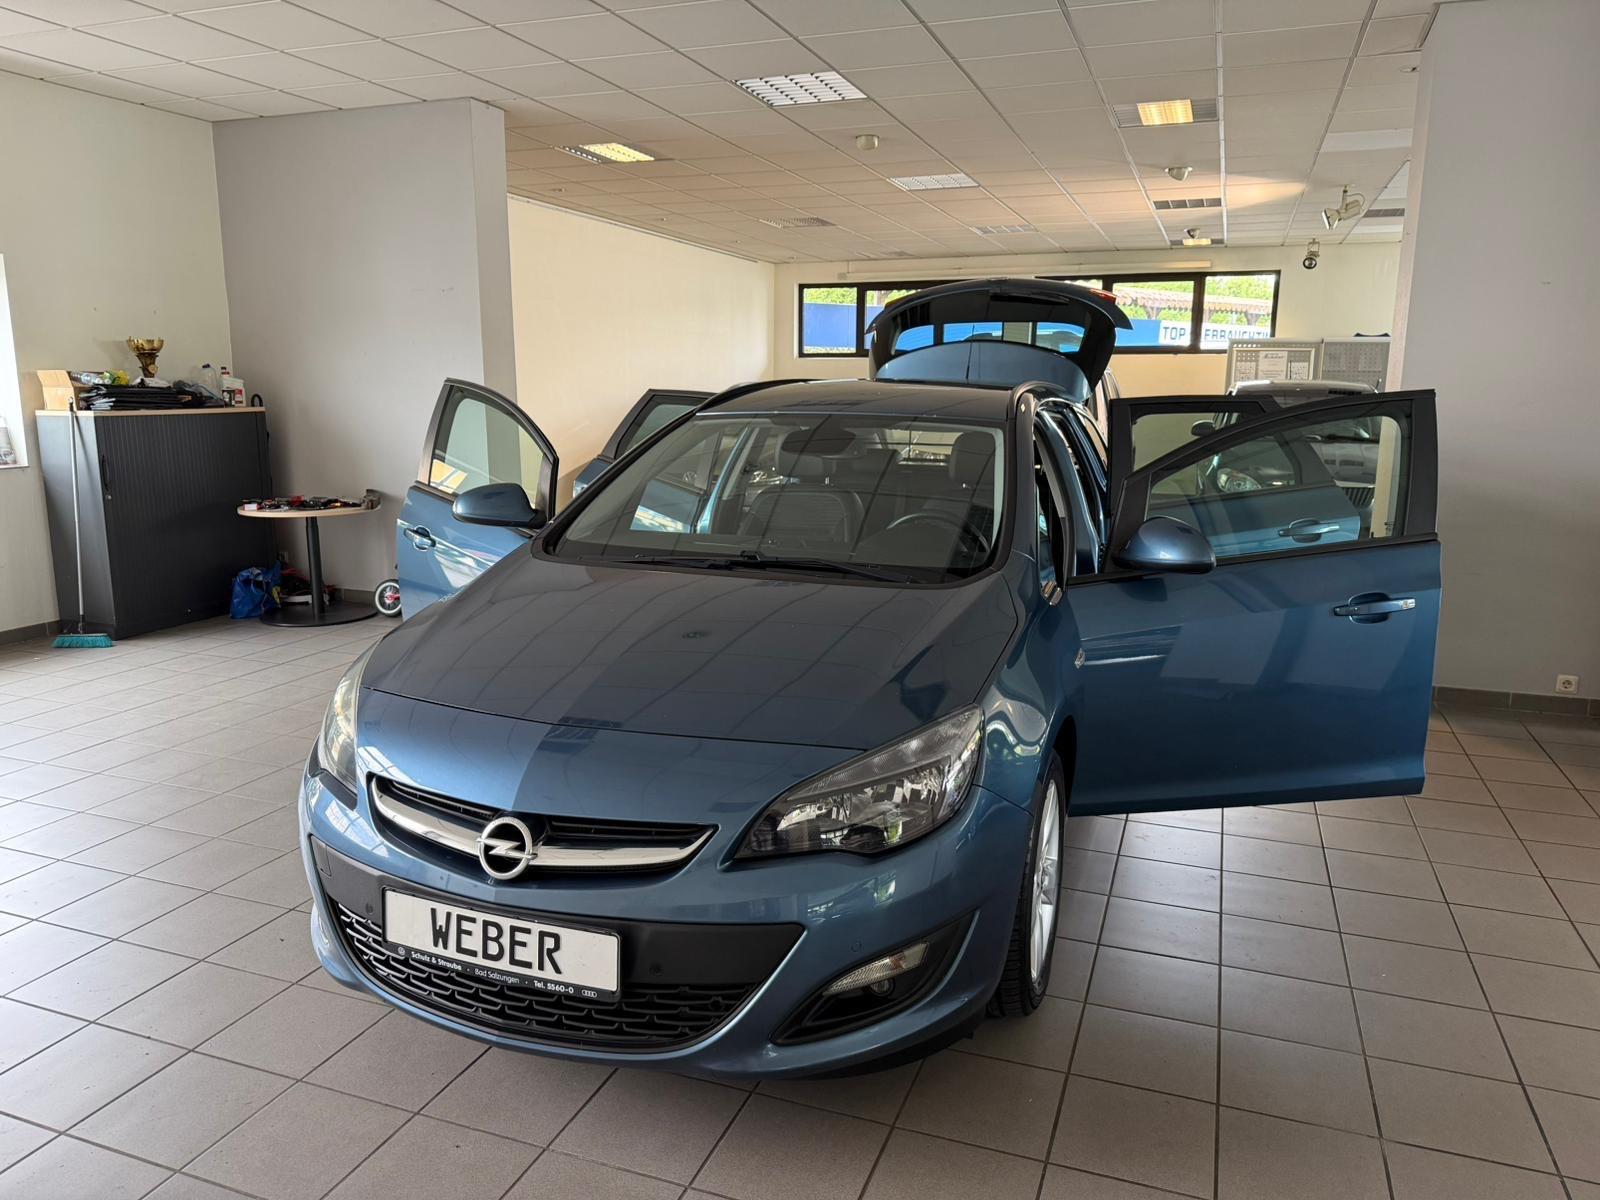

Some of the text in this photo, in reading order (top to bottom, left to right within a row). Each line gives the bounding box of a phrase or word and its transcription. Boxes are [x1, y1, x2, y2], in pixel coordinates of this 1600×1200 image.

[1163, 326, 1186, 341] TOP
[430, 907, 562, 974] WEBER
[431, 956, 437, 964] &
[474, 968, 487, 977] Bad
[533, 979, 546, 989] Tel.
[546, 982, 574, 994] 5560-0
